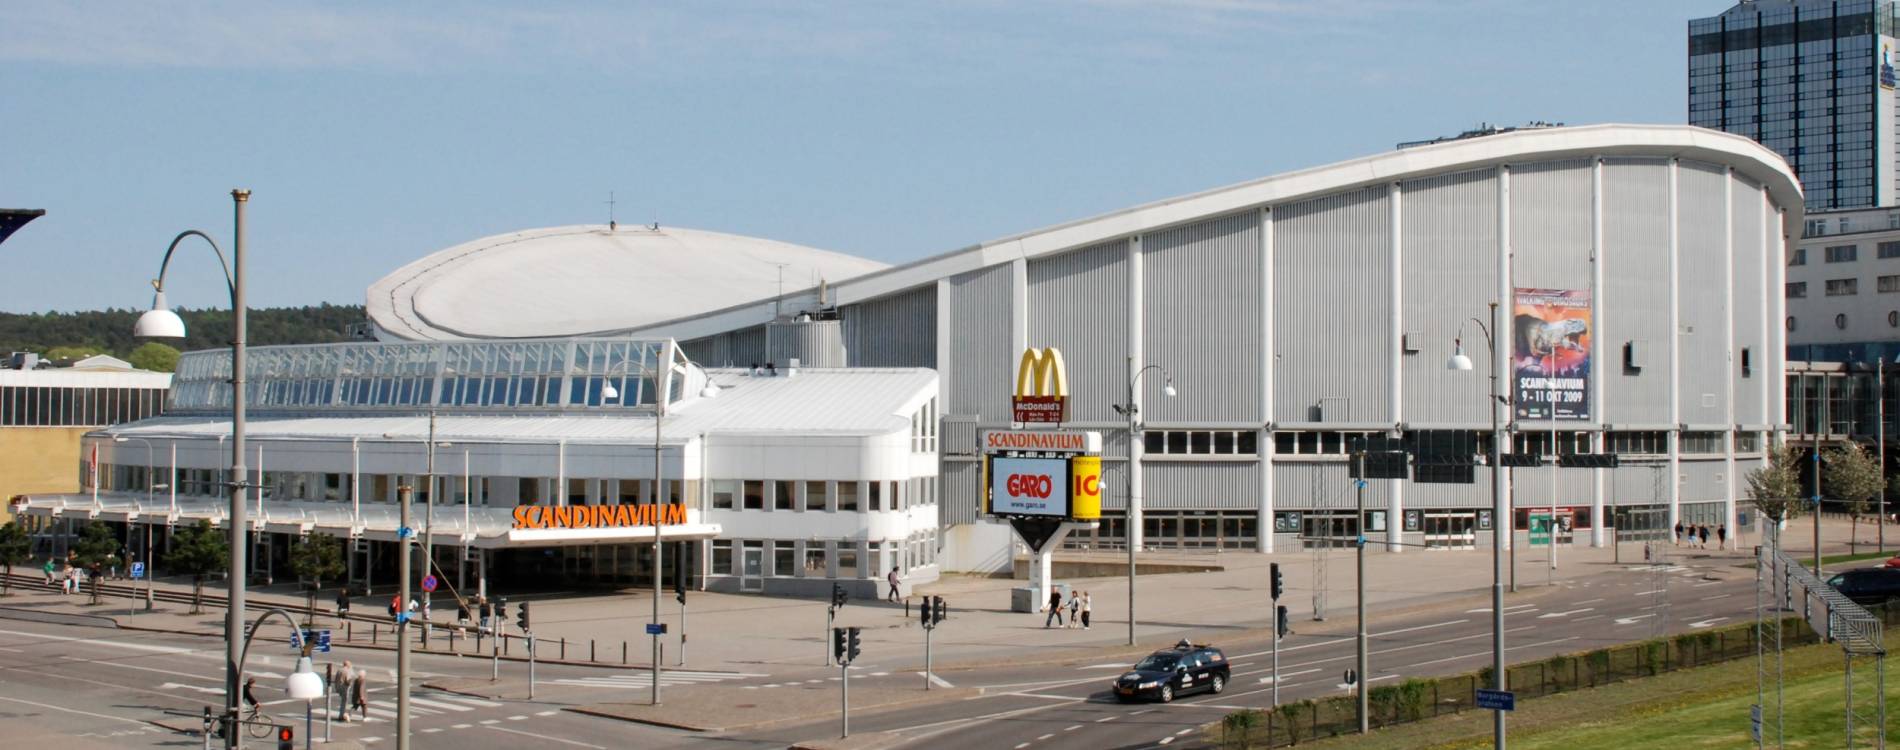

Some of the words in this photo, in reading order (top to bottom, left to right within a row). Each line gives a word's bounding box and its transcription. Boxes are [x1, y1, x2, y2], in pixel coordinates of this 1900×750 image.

[1520, 377, 1584, 390] SCANDAVIUM
[1522, 391, 1528, 402] 9
[1535, 391, 1544, 402] 11
[1563, 391, 1583, 402] 2009
[1016, 403, 1060, 411] McDonald's
[987, 432, 1084, 449] SCANDINAVIUM
[1007, 473, 1052, 499] GARO
[512, 503, 687, 529] SCANDINAVIUM
